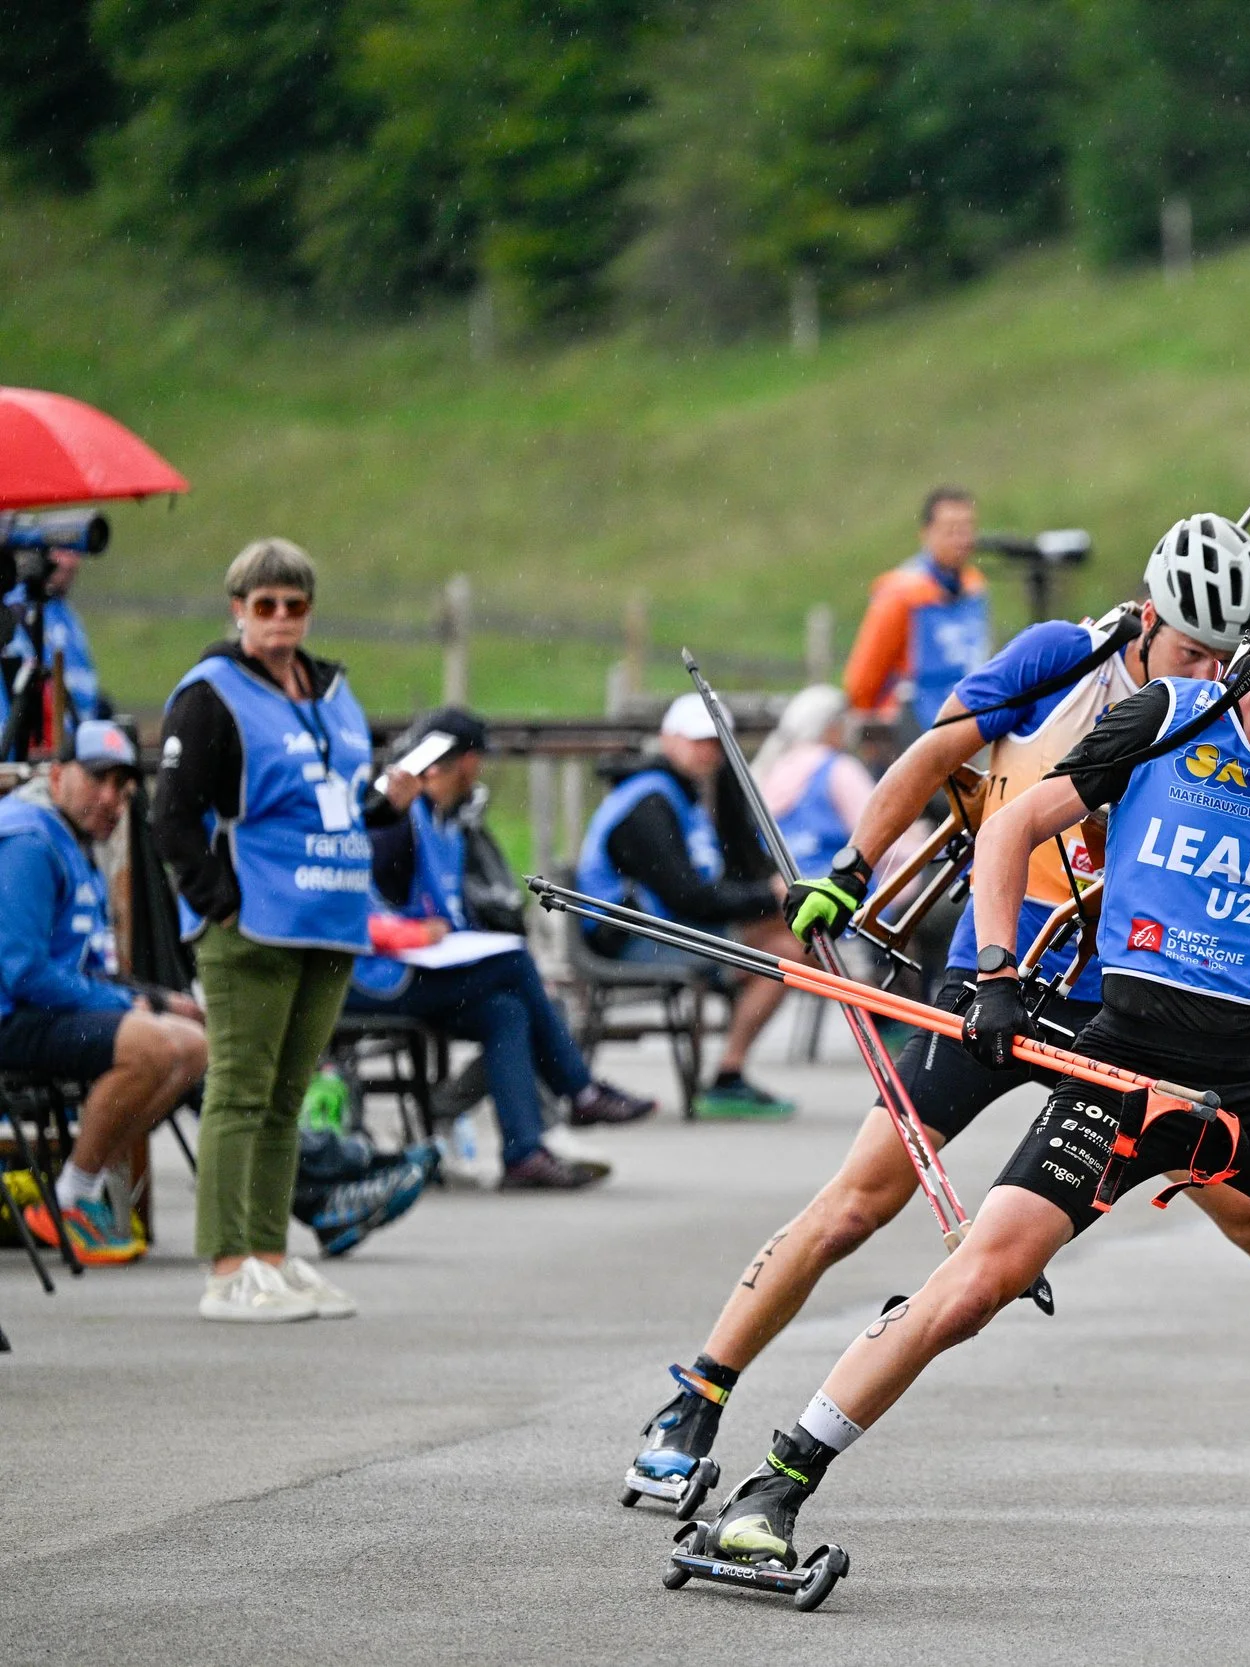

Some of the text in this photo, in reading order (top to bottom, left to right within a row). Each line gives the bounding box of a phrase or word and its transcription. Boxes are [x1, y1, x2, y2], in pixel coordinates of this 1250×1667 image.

[1169, 786, 1239, 815] MATÉRIAUX
[1166, 937, 1245, 965] D'EPARGNE
[1168, 927, 1219, 948] CAISSE
[1165, 950, 1199, 965] Rhône
[1073, 1101, 1120, 1135] som
[1078, 1126, 1104, 1143] Jean
[1065, 1141, 1104, 1172] La Région
[1041, 1160, 1081, 1189] mgen
